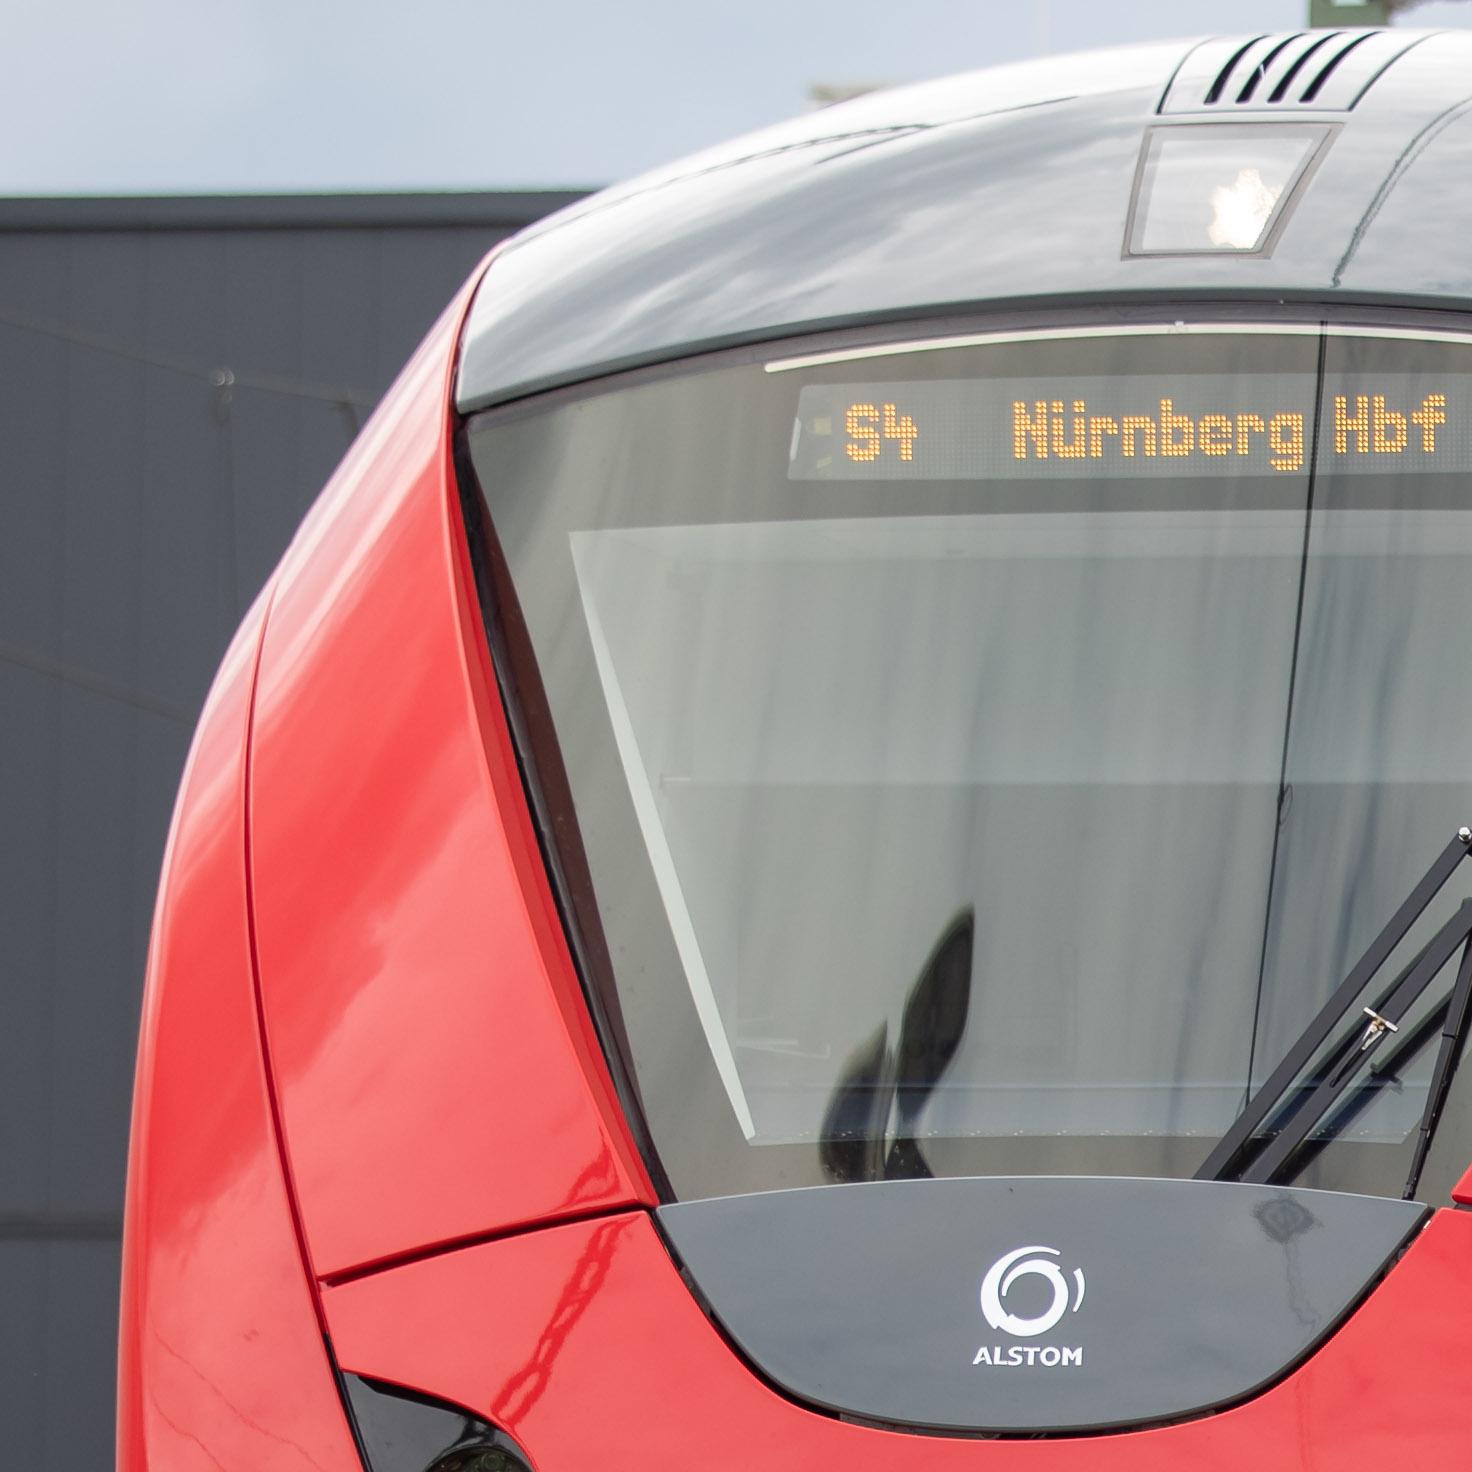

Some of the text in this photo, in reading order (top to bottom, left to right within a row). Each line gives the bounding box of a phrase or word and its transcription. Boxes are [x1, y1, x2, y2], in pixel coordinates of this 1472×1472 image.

[846, 394, 1447, 471] S4 Nürnberg Hbf
[972, 1347, 1083, 1367] ALSTOM
